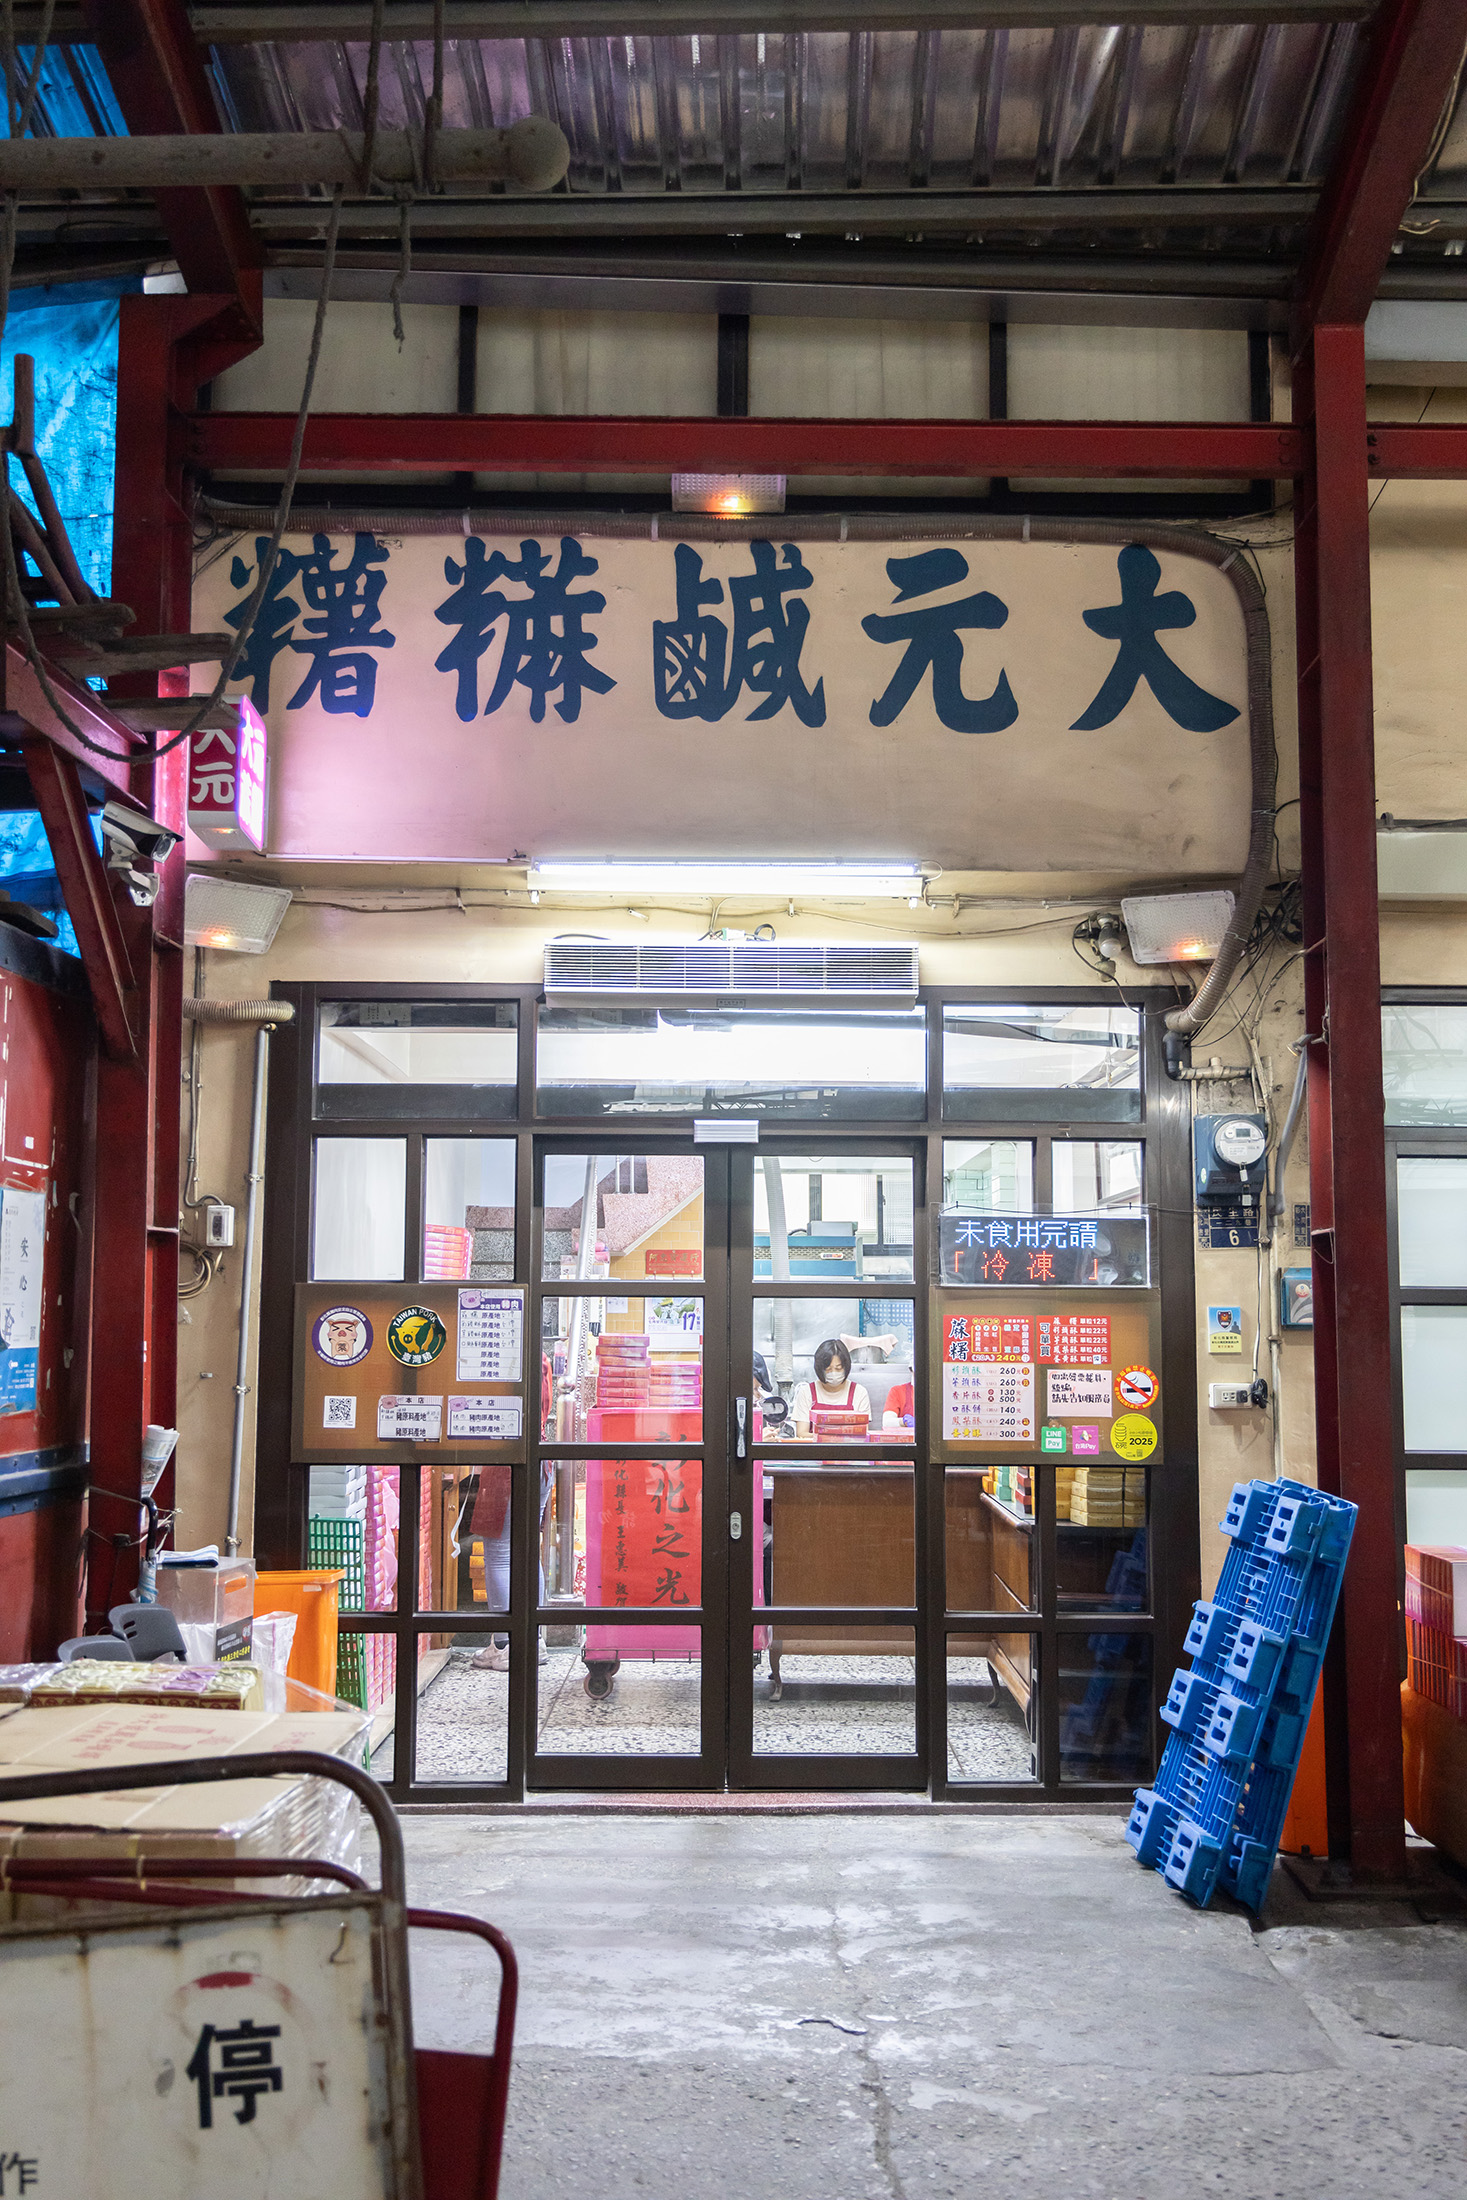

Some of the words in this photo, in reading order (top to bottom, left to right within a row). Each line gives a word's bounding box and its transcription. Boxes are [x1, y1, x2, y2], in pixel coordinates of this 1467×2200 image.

[955, 1220, 1098, 1249] 未食用完請
[1229, 1230, 1240, 1246] 6
[393, 1308, 418, 1327] TAIWAN
[419, 1309, 438, 1323] PORK
[682, 1312, 696, 1331] 17
[1047, 1439, 1060, 1447] Pay
[1129, 1437, 1153, 1446] 2025
[185, 2019, 283, 2129] 停
